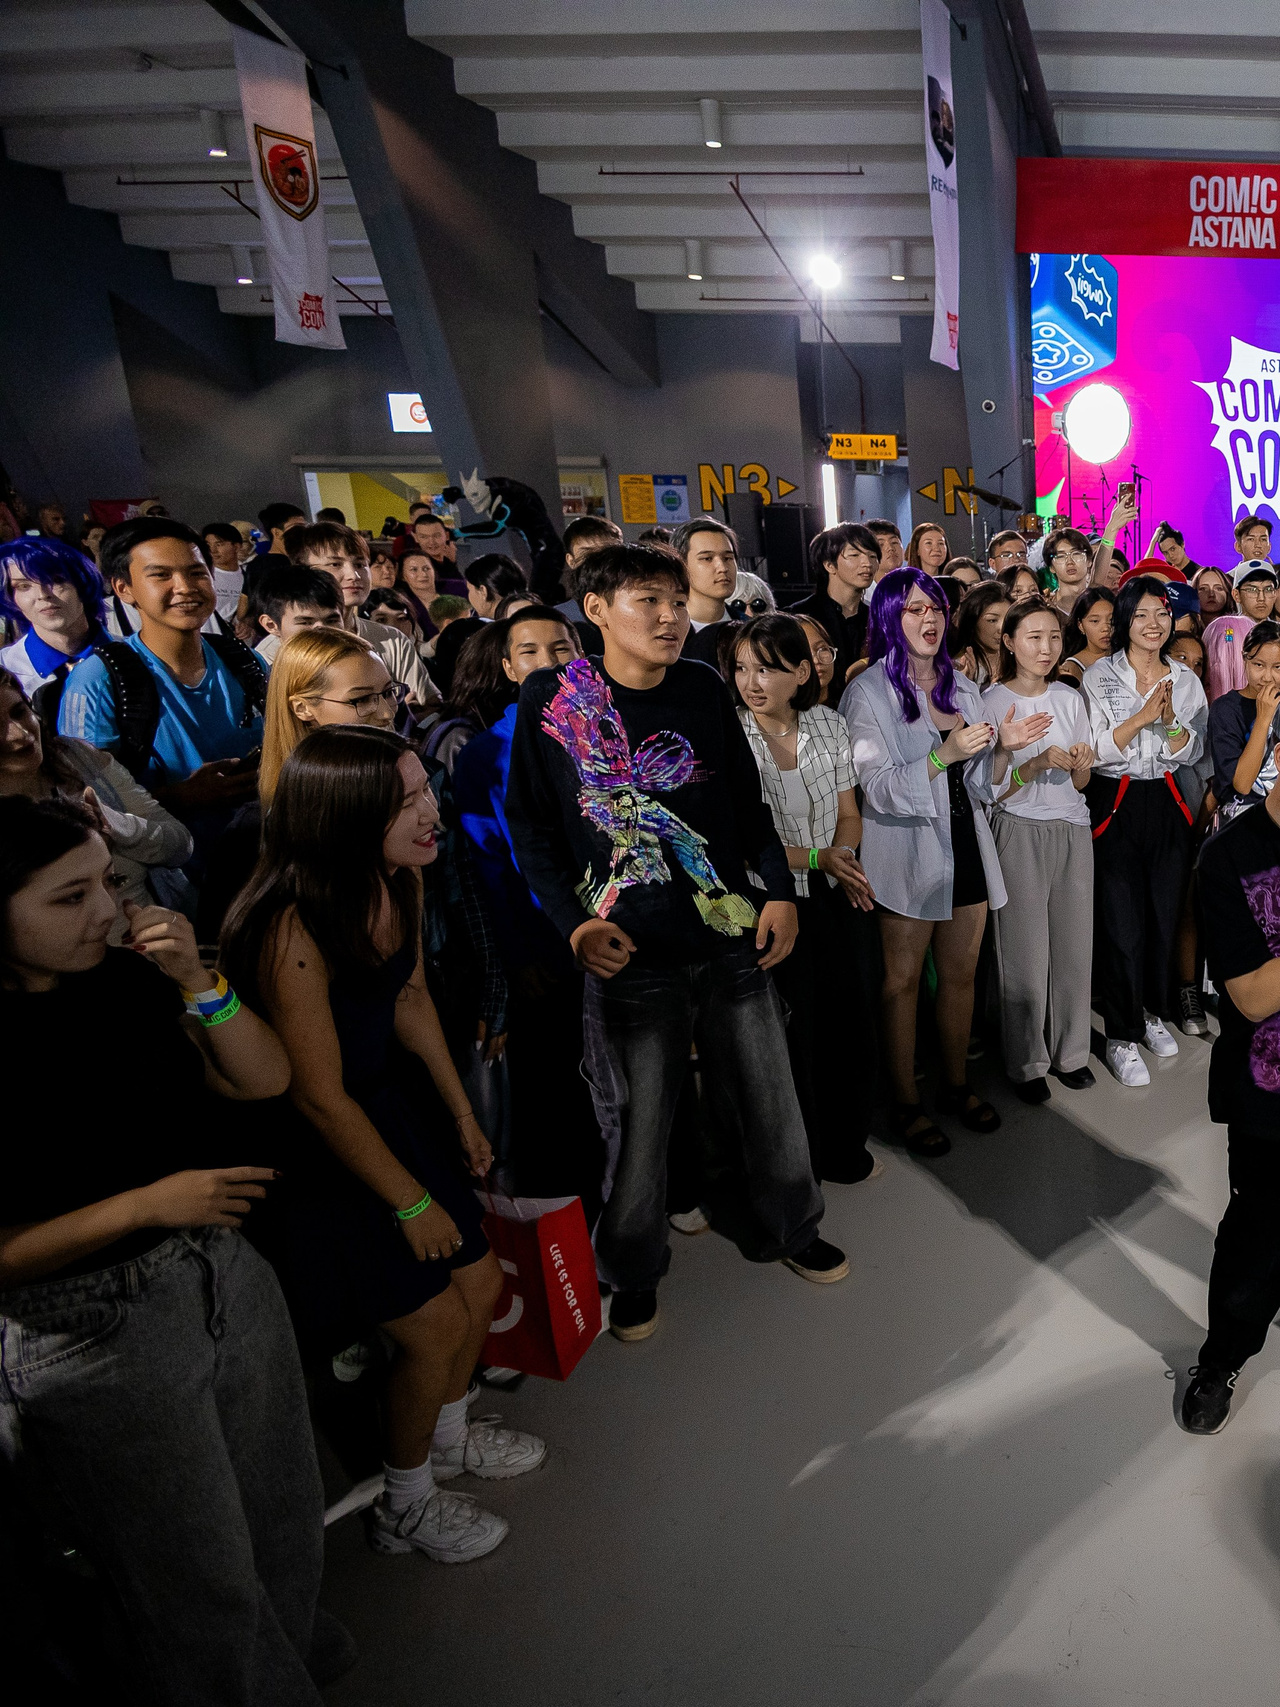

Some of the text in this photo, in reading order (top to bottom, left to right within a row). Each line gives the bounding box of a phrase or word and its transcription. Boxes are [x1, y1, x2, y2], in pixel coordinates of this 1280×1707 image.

[1189, 175, 1278, 214] COM!C
[1188, 215, 1277, 249] ASTANA
[835, 438, 887, 448] N3 N4
[698, 463, 772, 512] N3
[549, 1243, 565, 1270] LIFE
[557, 1268, 569, 1283] IS
[563, 1282, 578, 1309] FOR
